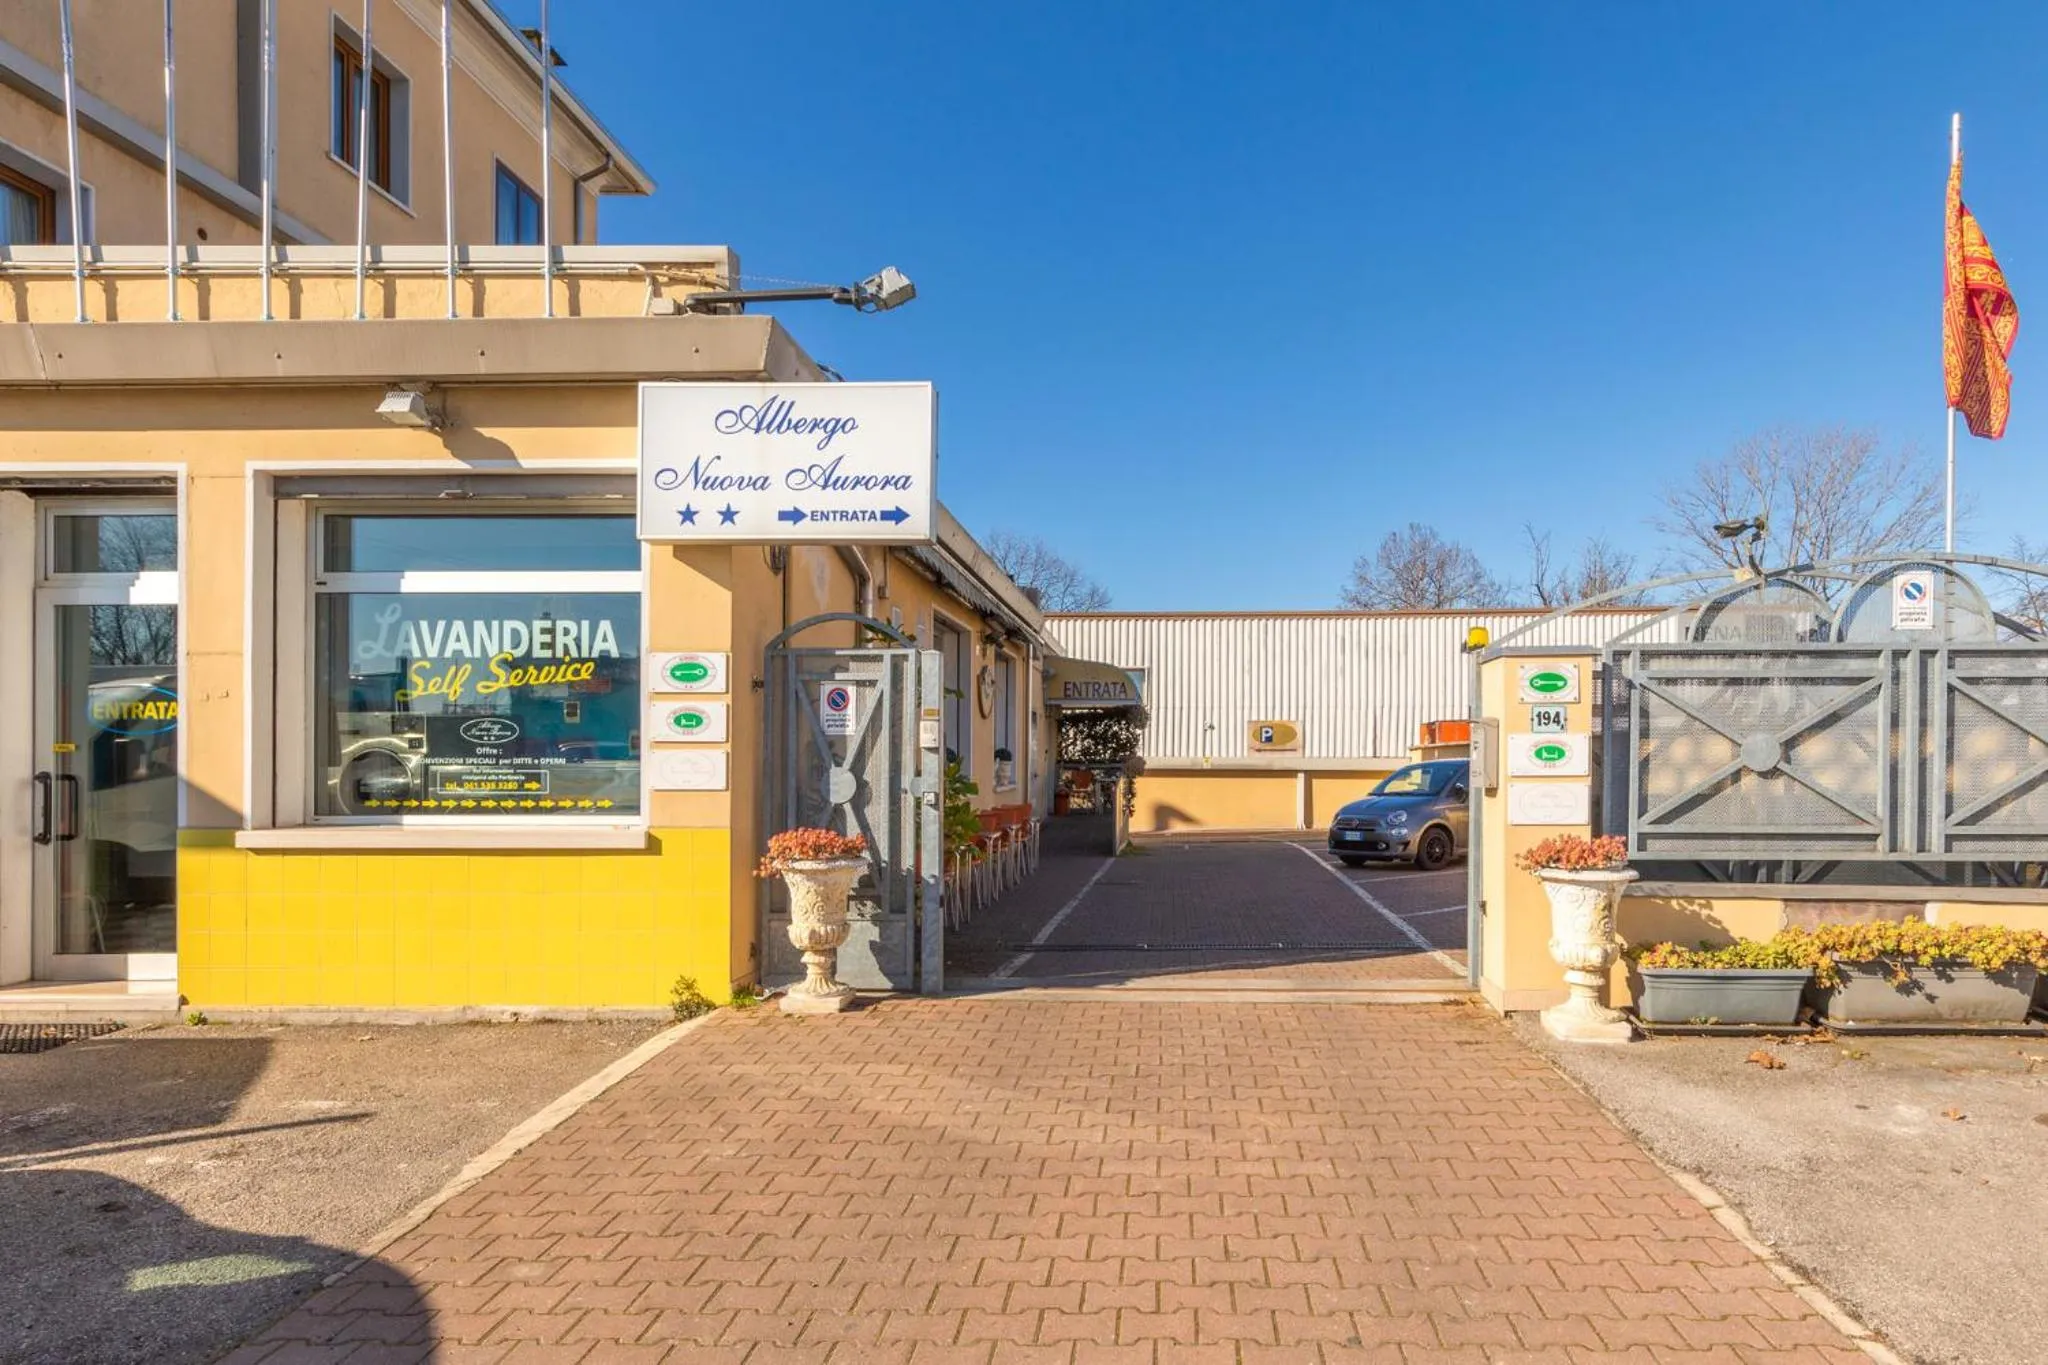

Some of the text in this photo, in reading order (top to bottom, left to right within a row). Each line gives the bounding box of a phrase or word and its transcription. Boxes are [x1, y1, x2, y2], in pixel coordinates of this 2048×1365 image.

[714, 393, 859, 451] Albergo
[654, 455, 914, 492] Nuova Aurora
[809, 508, 878, 523] ENTRATA
[358, 602, 620, 659] LAVANDERIA
[394, 650, 596, 703] Self Service
[1062, 680, 1129, 699] ENTRATA
[92, 699, 178, 721] ENTRATA
[1261, 727, 1273, 742] P
